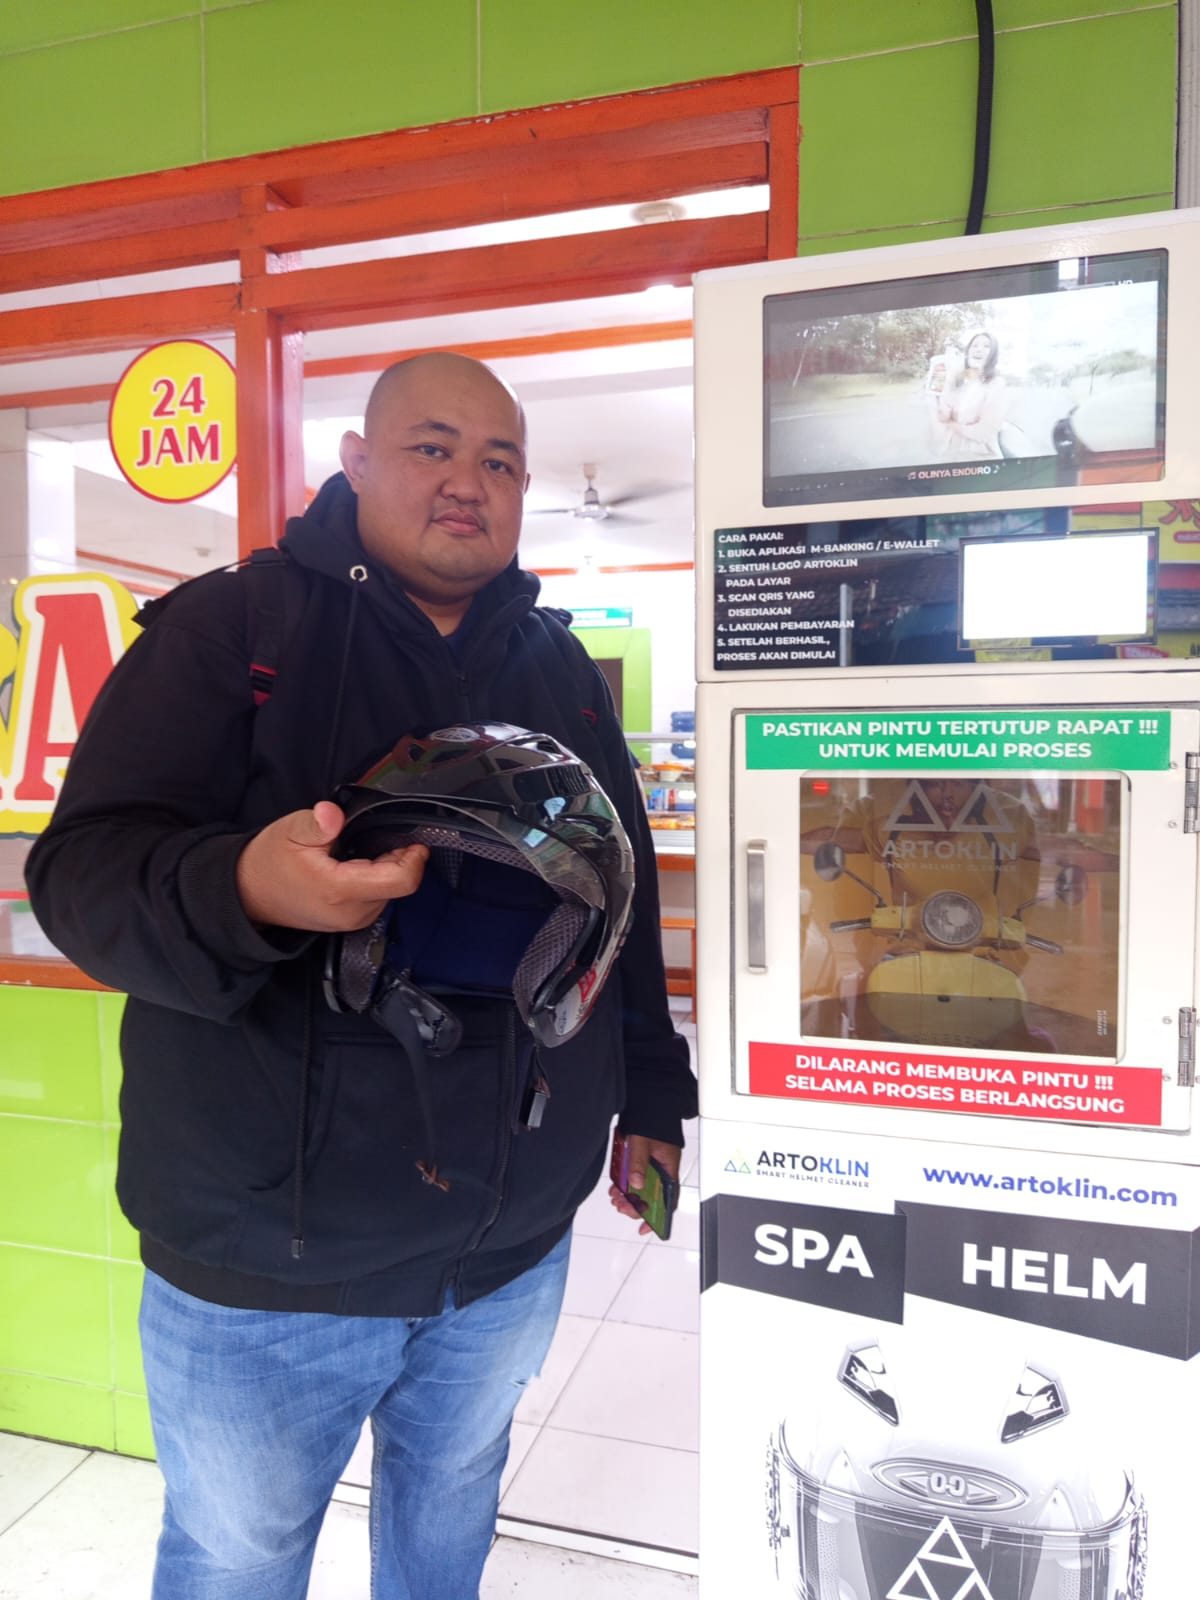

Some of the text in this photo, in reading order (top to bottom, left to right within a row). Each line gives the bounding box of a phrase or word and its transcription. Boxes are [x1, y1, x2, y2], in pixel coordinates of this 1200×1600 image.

[152, 376, 206, 417] 24
[136, 423, 220, 467] JAM
[952, 466, 991, 477] ENDURO
[718, 531, 784, 543] CARA PAKAI:
[727, 548, 757, 558] BUKA
[758, 545, 806, 556] APLIKASI
[810, 541, 874, 554] M-BANKING
[875, 540, 882, 552] /
[883, 539, 940, 550] E-WALLET
[718, 558, 858, 573] 2. SENTUH LOGO ARTOKLIN
[725, 576, 792, 588] PADA LAYAR
[717, 590, 815, 603] 3. SCAN QRIS YANG
[728, 607, 792, 617] DISEDIAKAN
[717, 620, 855, 632] 4. LAKUKAN PEMBAYARAN
[717, 635, 831, 647] 5. SETELAH BERHASIL,
[717, 650, 836, 662] PROSES AKAN DIMULAI
[762, 719, 1159, 737] PASTIKAN PINTU TERTUTUP RAPAT !!!
[818, 742, 1092, 758] UNTUK MEMULAI PROSES
[881, 839, 1017, 861] ARTOKLIN
[795, 1054, 1114, 1091] DILARANG MEMBUKA PINTU !!!
[785, 1074, 1125, 1114] SELAMA PROSES BERLANGSUNG
[757, 1150, 869, 1178] ARTOKLIN
[756, 1169, 869, 1188] SMART HELMET CLEANER
[922, 1167, 1178, 1207] www.artoklin.com
[753, 1223, 874, 1278] SPA
[962, 1242, 1147, 1305] HELM
